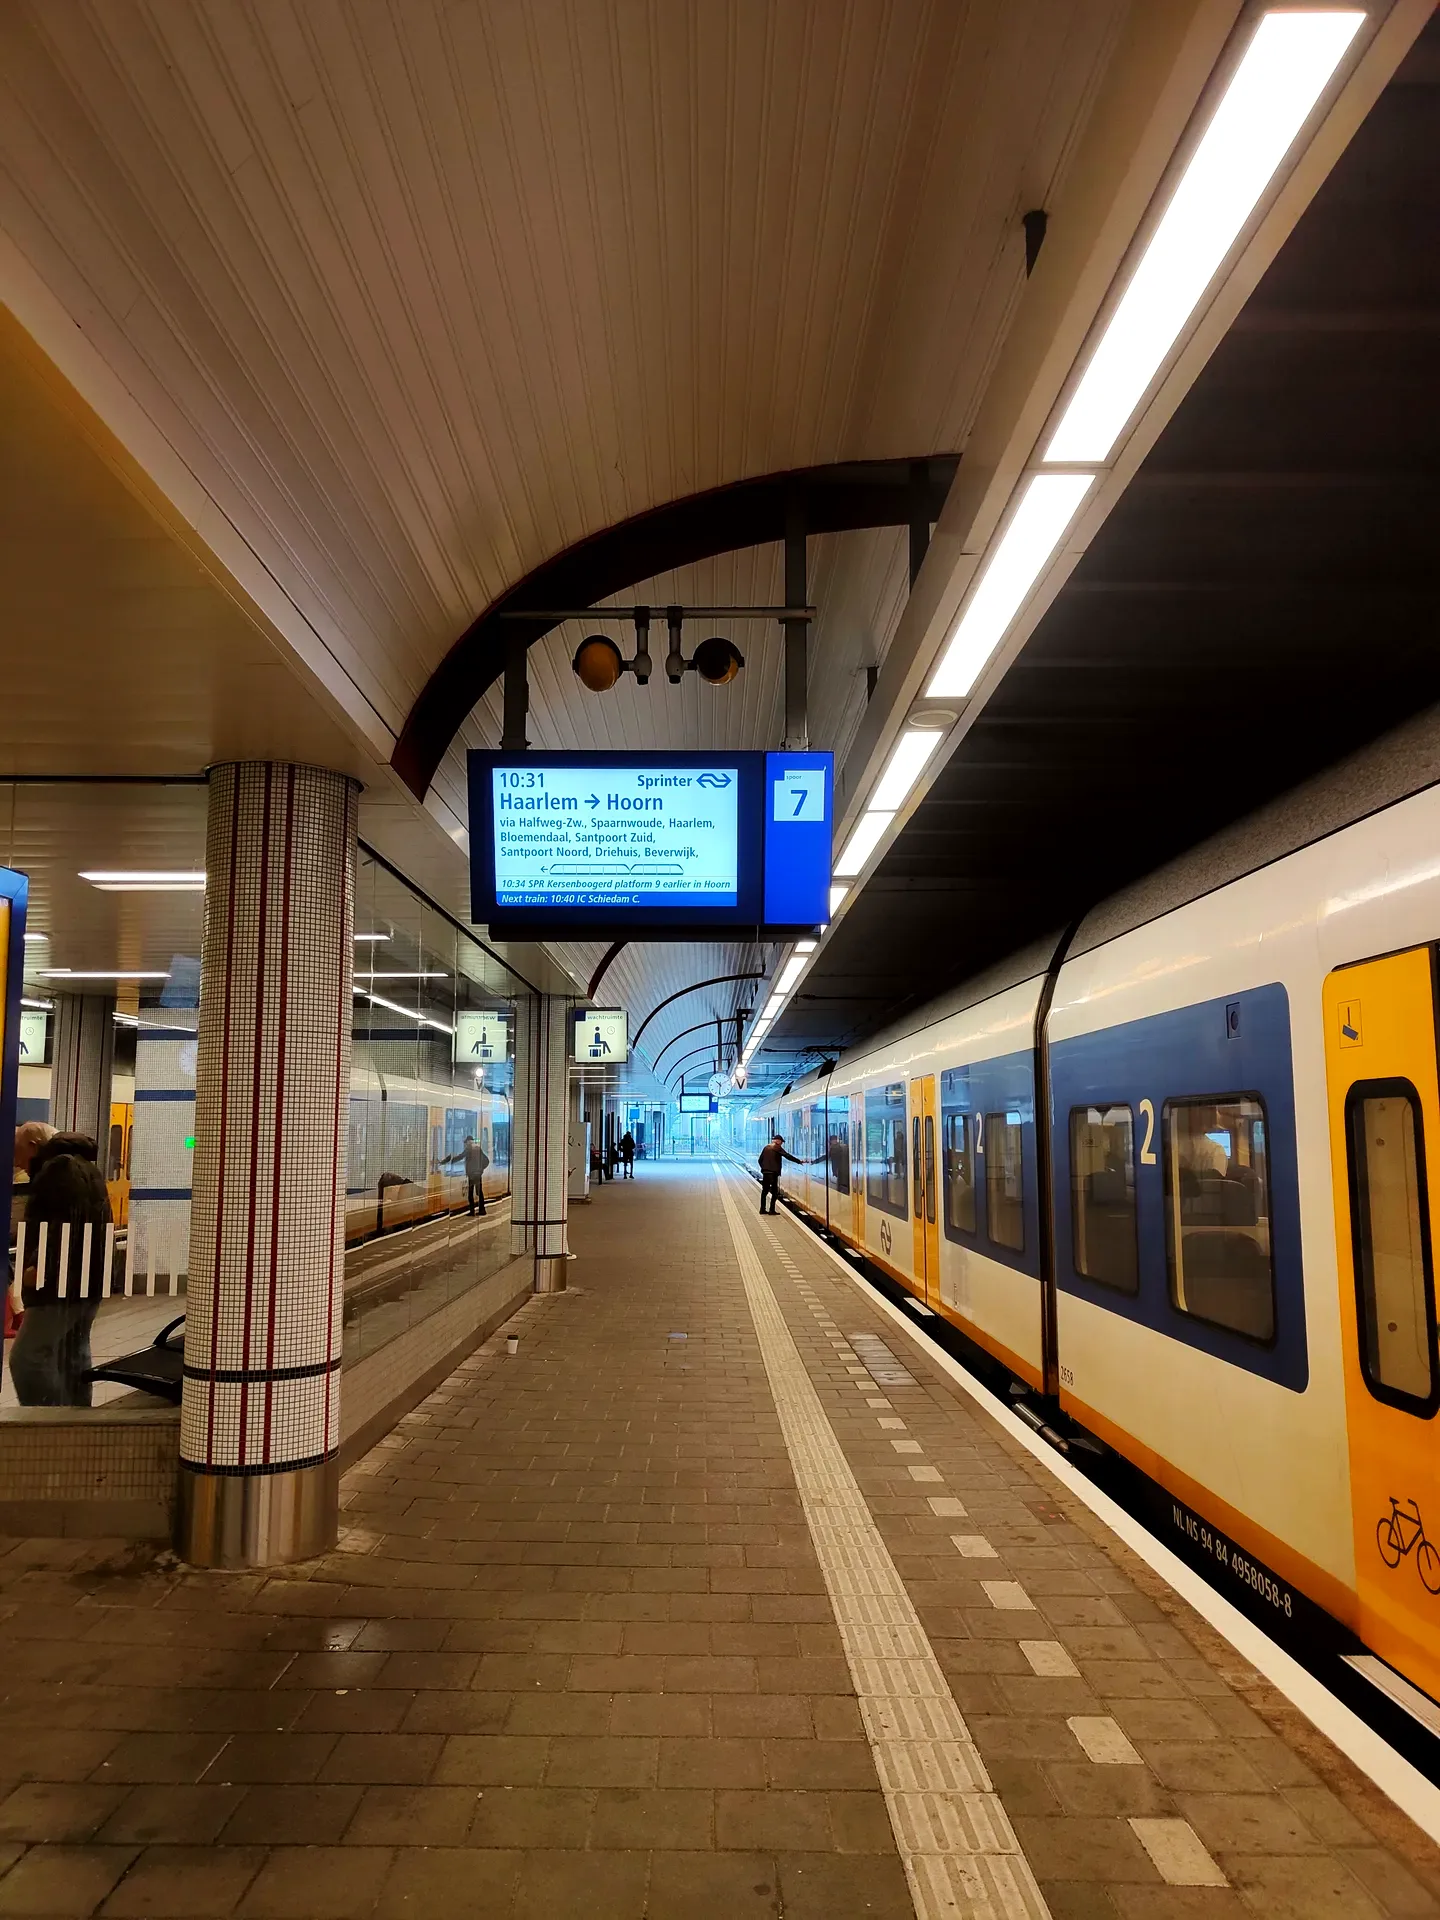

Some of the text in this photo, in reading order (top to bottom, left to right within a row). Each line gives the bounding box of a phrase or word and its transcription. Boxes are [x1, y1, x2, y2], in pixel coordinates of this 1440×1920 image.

[500, 772, 544, 788] 10:31
[637, 774, 693, 790] Sprinter
[500, 792, 663, 811] Haarlem Hoorn
[790, 789, 808, 816] 7
[499, 817, 716, 830] via Halfweg-Zw., Spaarnwoude, Haarlem,
[500, 831, 656, 845] Bloemendaal, Santpoort Zuid,
[500, 846, 699, 860] Santpoort Noord, Driehuis, Beverwijk,
[502, 879, 731, 890] 10:34 SPR Kersenboogerd platform 9 earlier in Hoorn
[501, 894, 641, 904] Next train: 10:40 IC Schiedam C.
[975, 1111, 984, 1154] 2
[1139, 1098, 1157, 1165] 2
[1060, 1365, 1074, 1387] 2658
[1173, 1504, 1292, 1618] NL NS 94 84 4958058-8
